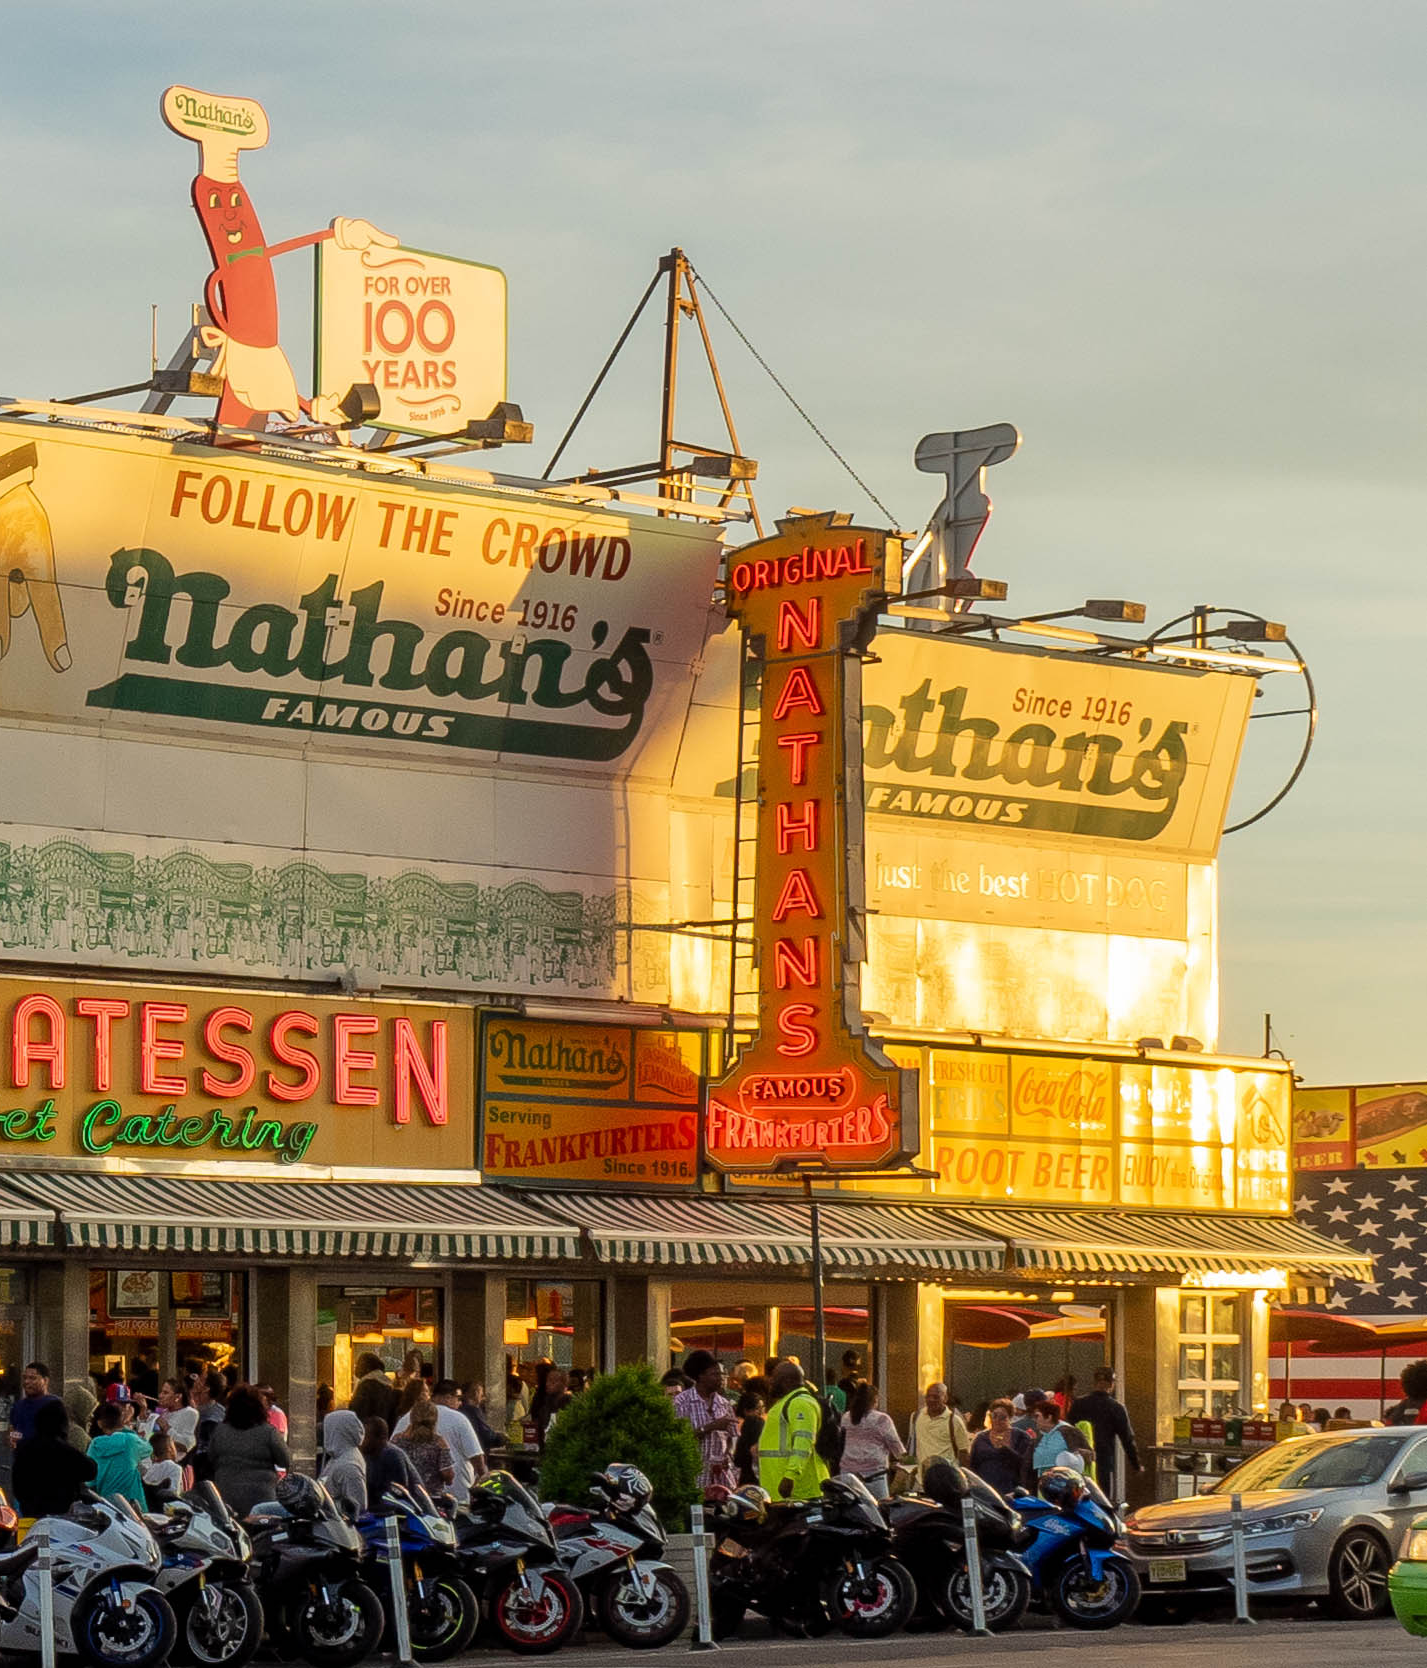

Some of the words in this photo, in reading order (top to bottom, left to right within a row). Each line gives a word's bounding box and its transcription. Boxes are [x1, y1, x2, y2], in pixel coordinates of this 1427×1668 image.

[174, 93, 255, 130] Nathan's
[364, 276, 401, 296] FOR
[405, 276, 452, 297] OVER
[364, 299, 456, 355] 100
[363, 360, 457, 390] YEARS
[170, 469, 358, 542] FOLLOW
[376, 501, 460, 557] THE
[482, 518, 633, 582] CROWD
[733, 538, 873, 592] ORIGINAL
[105, 547, 653, 717] Nathan's
[434, 587, 506, 628] Since
[517, 598, 578, 633] 1916
[261, 697, 456, 740] FAMOUS
[1012, 688, 1072, 719] Since
[1082, 696, 1132, 727] 1916
[862, 678, 1189, 801] athan's
[772, 597, 821, 1057] NATHANS
[867, 786, 1029, 823] FAMOUS
[874, 852, 923, 893] just
[930, 857, 971, 894] the
[979, 863, 1030, 899] best
[489, 1027, 628, 1076] Nathan's
[933, 1060, 976, 1083] FRESH
[979, 1063, 1006, 1085] CUT
[752, 1077, 843, 1099] FAMOUS
[81, 1099, 319, 1164] Catering
[488, 1106, 553, 1130] Serving
[708, 1093, 891, 1150] FRANKFURTERS
[486, 1112, 696, 1170] FRANKFURTERS
[1293, 1151, 1343, 1169] EER
[603, 1158, 646, 1177] Since
[651, 1158, 693, 1177] 1916.
[936, 1146, 1025, 1187] ROOT
[1033, 1151, 1110, 1191] BEER
[1123, 1154, 1170, 1187] ENJOY
